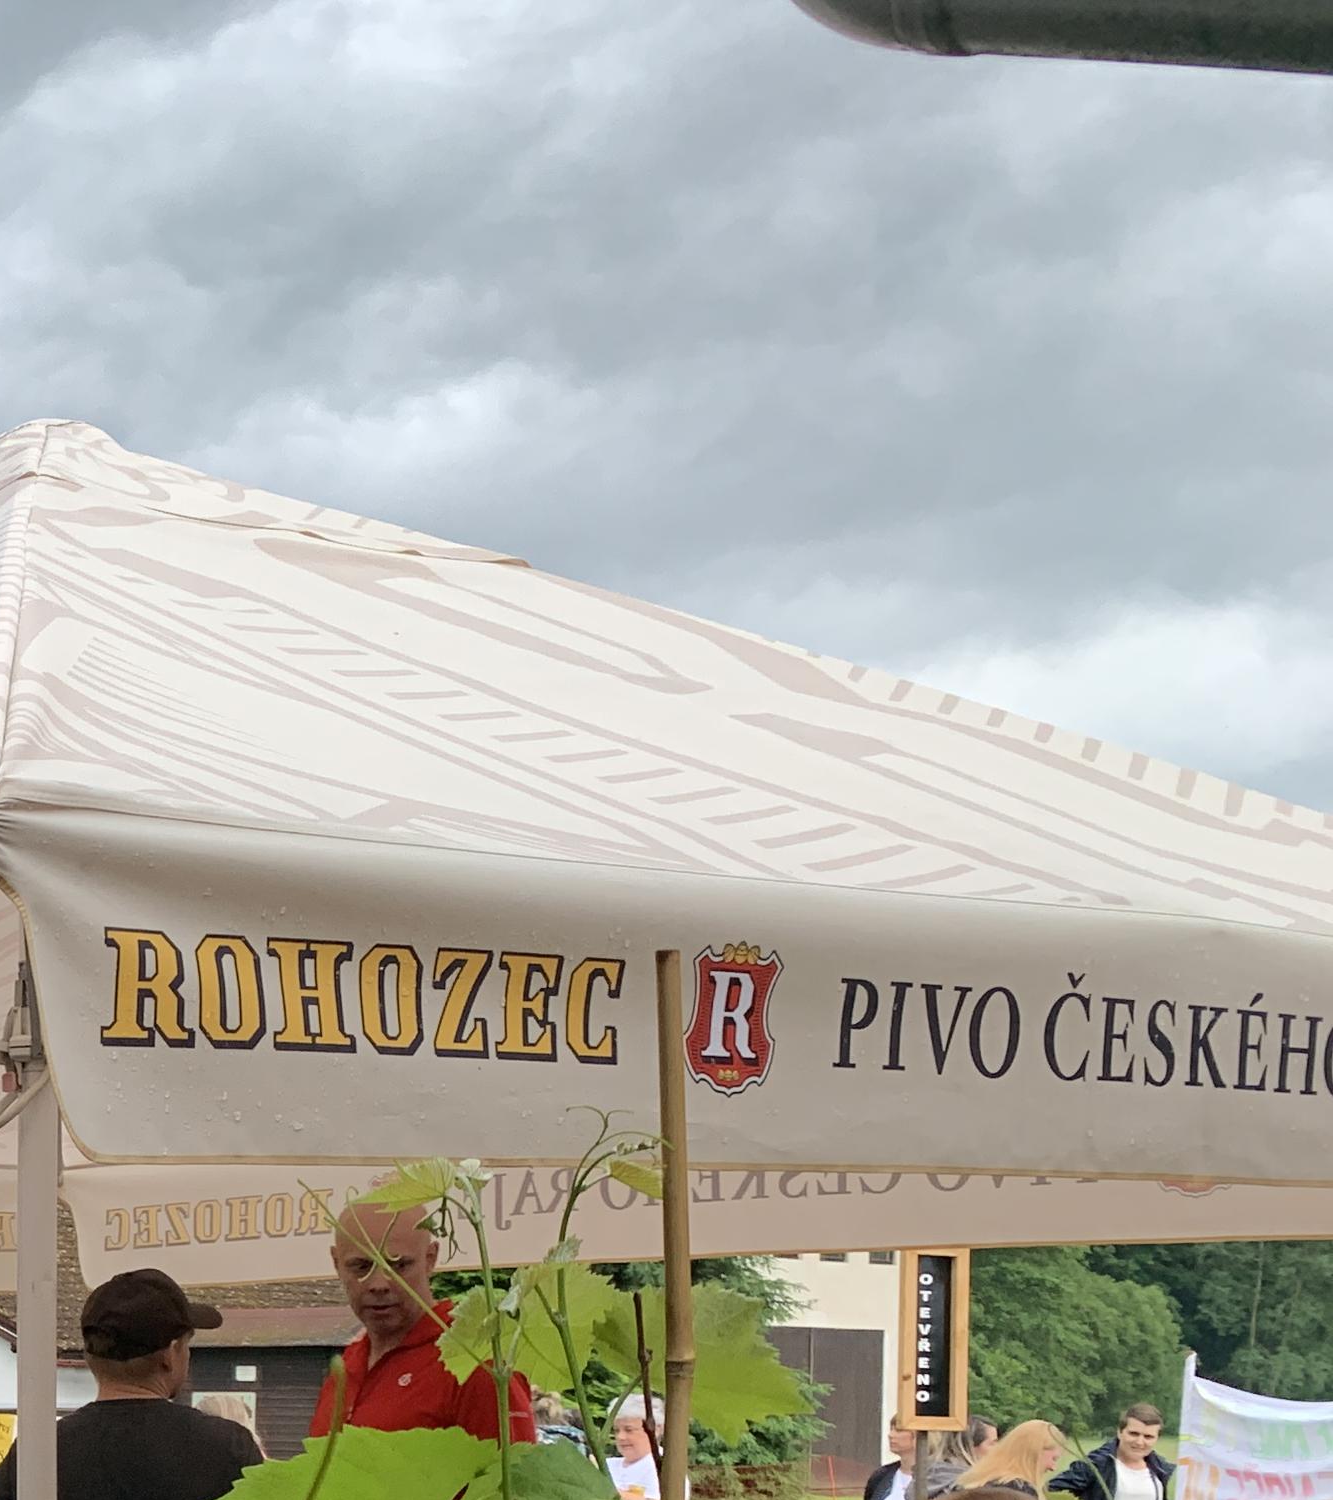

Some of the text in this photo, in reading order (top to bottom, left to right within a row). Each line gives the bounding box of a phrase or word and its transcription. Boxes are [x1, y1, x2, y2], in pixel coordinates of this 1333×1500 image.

[100, 926, 1333, 1097] ROHOZEC R PIVO ČESKÉH
[916, 1273, 934, 1403] OTEVŘENO
